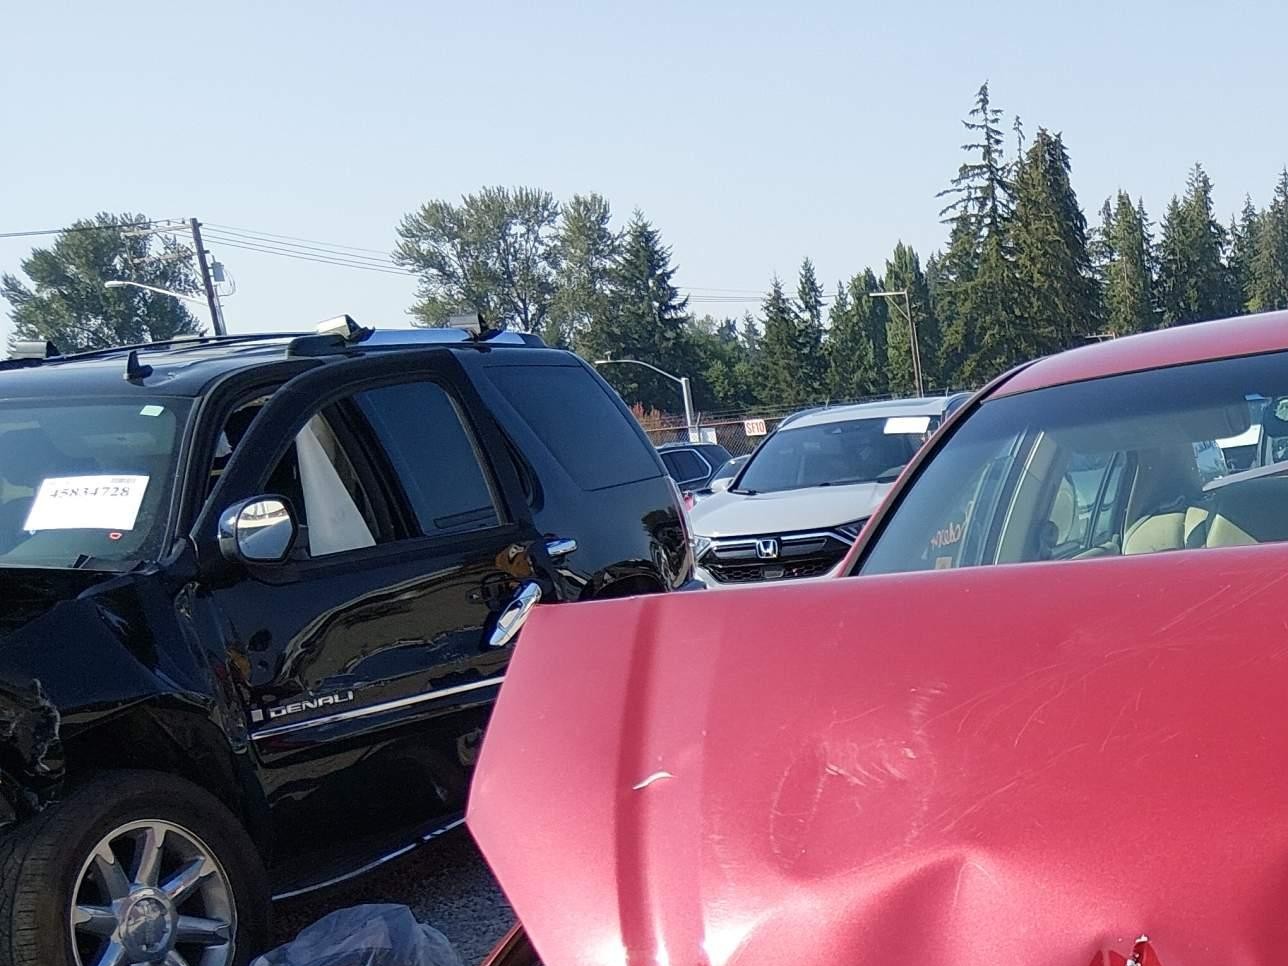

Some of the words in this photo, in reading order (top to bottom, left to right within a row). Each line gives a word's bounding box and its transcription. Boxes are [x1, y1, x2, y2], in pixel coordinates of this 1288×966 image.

[746, 420, 764, 433] SF10
[49, 486, 130, 499] 45834728
[269, 690, 354, 718] DENALI
